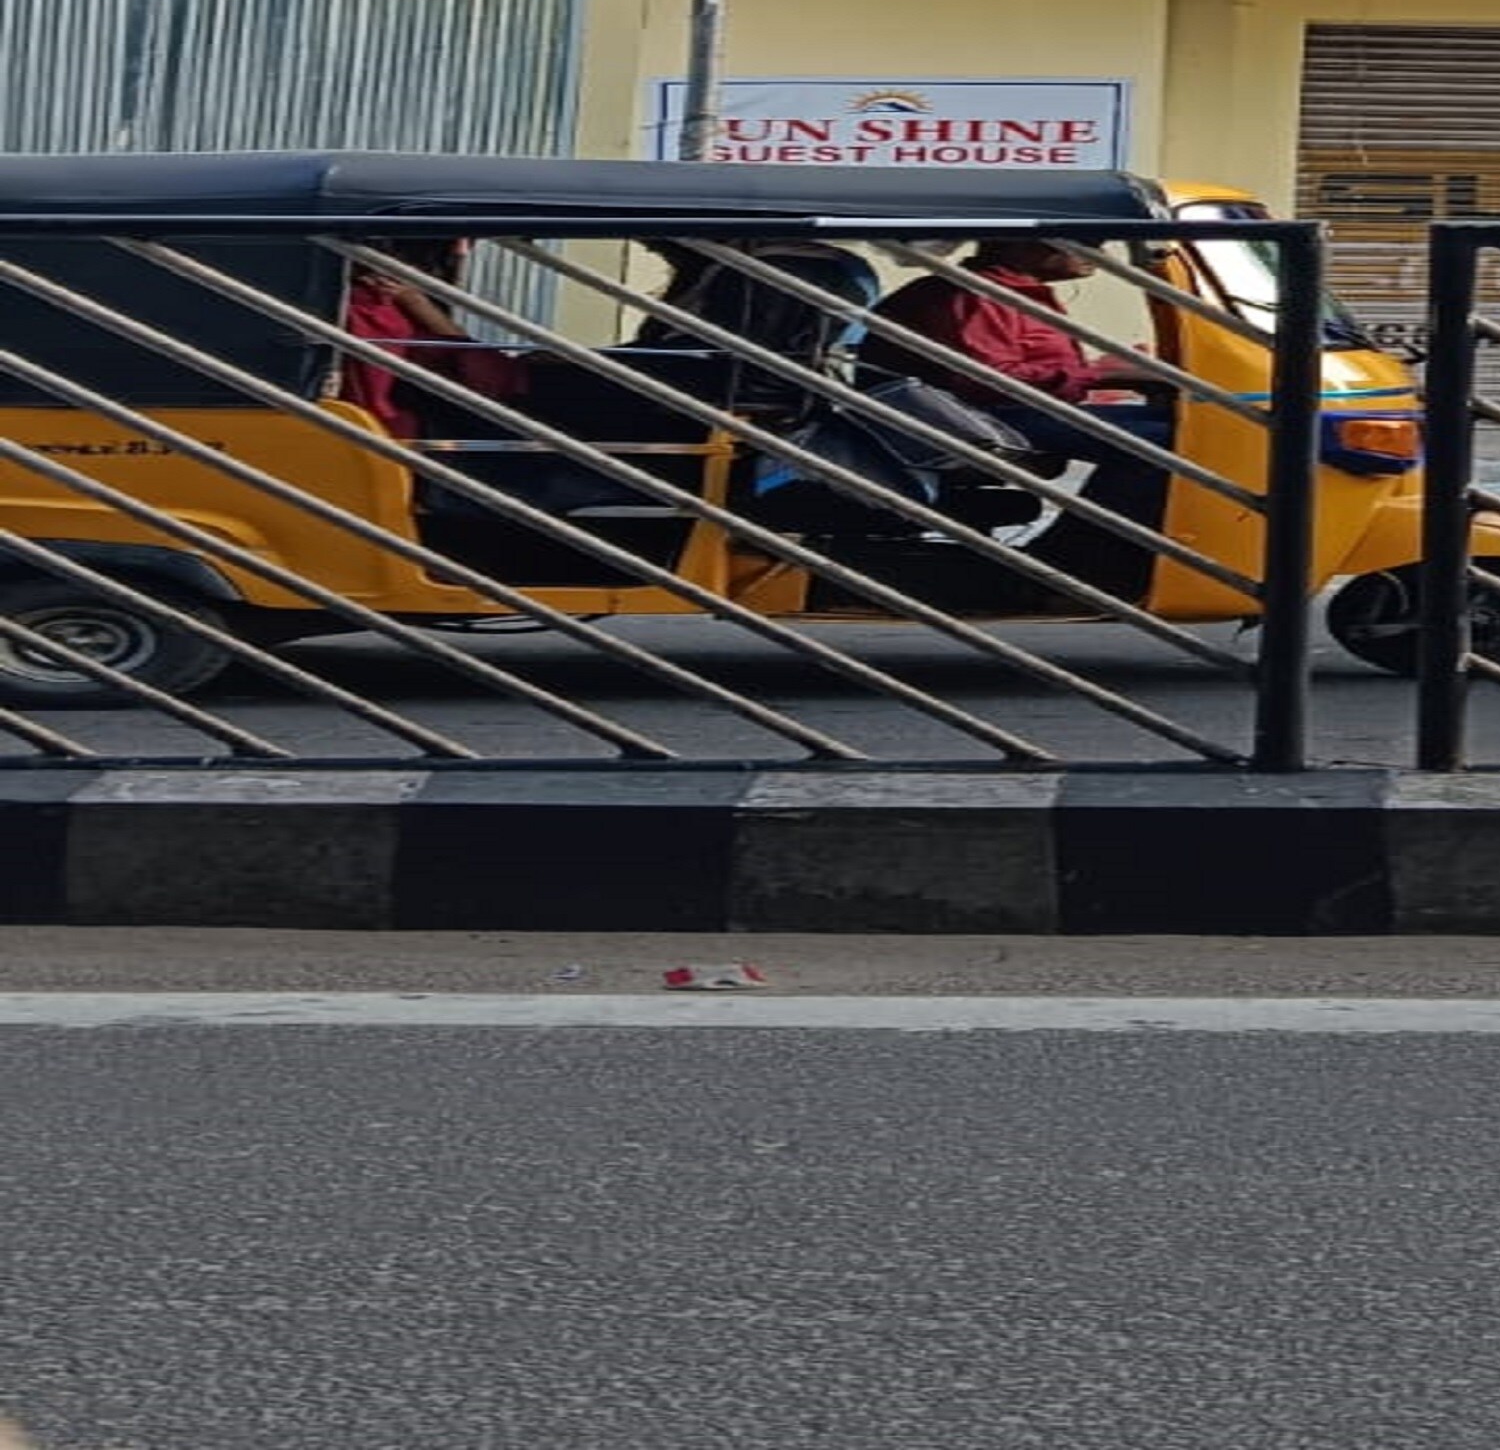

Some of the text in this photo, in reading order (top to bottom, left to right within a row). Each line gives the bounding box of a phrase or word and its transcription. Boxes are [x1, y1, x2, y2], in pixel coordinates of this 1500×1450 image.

[722, 118, 1099, 145] UN SHINE
[893, 145, 1078, 166] HOUSE
